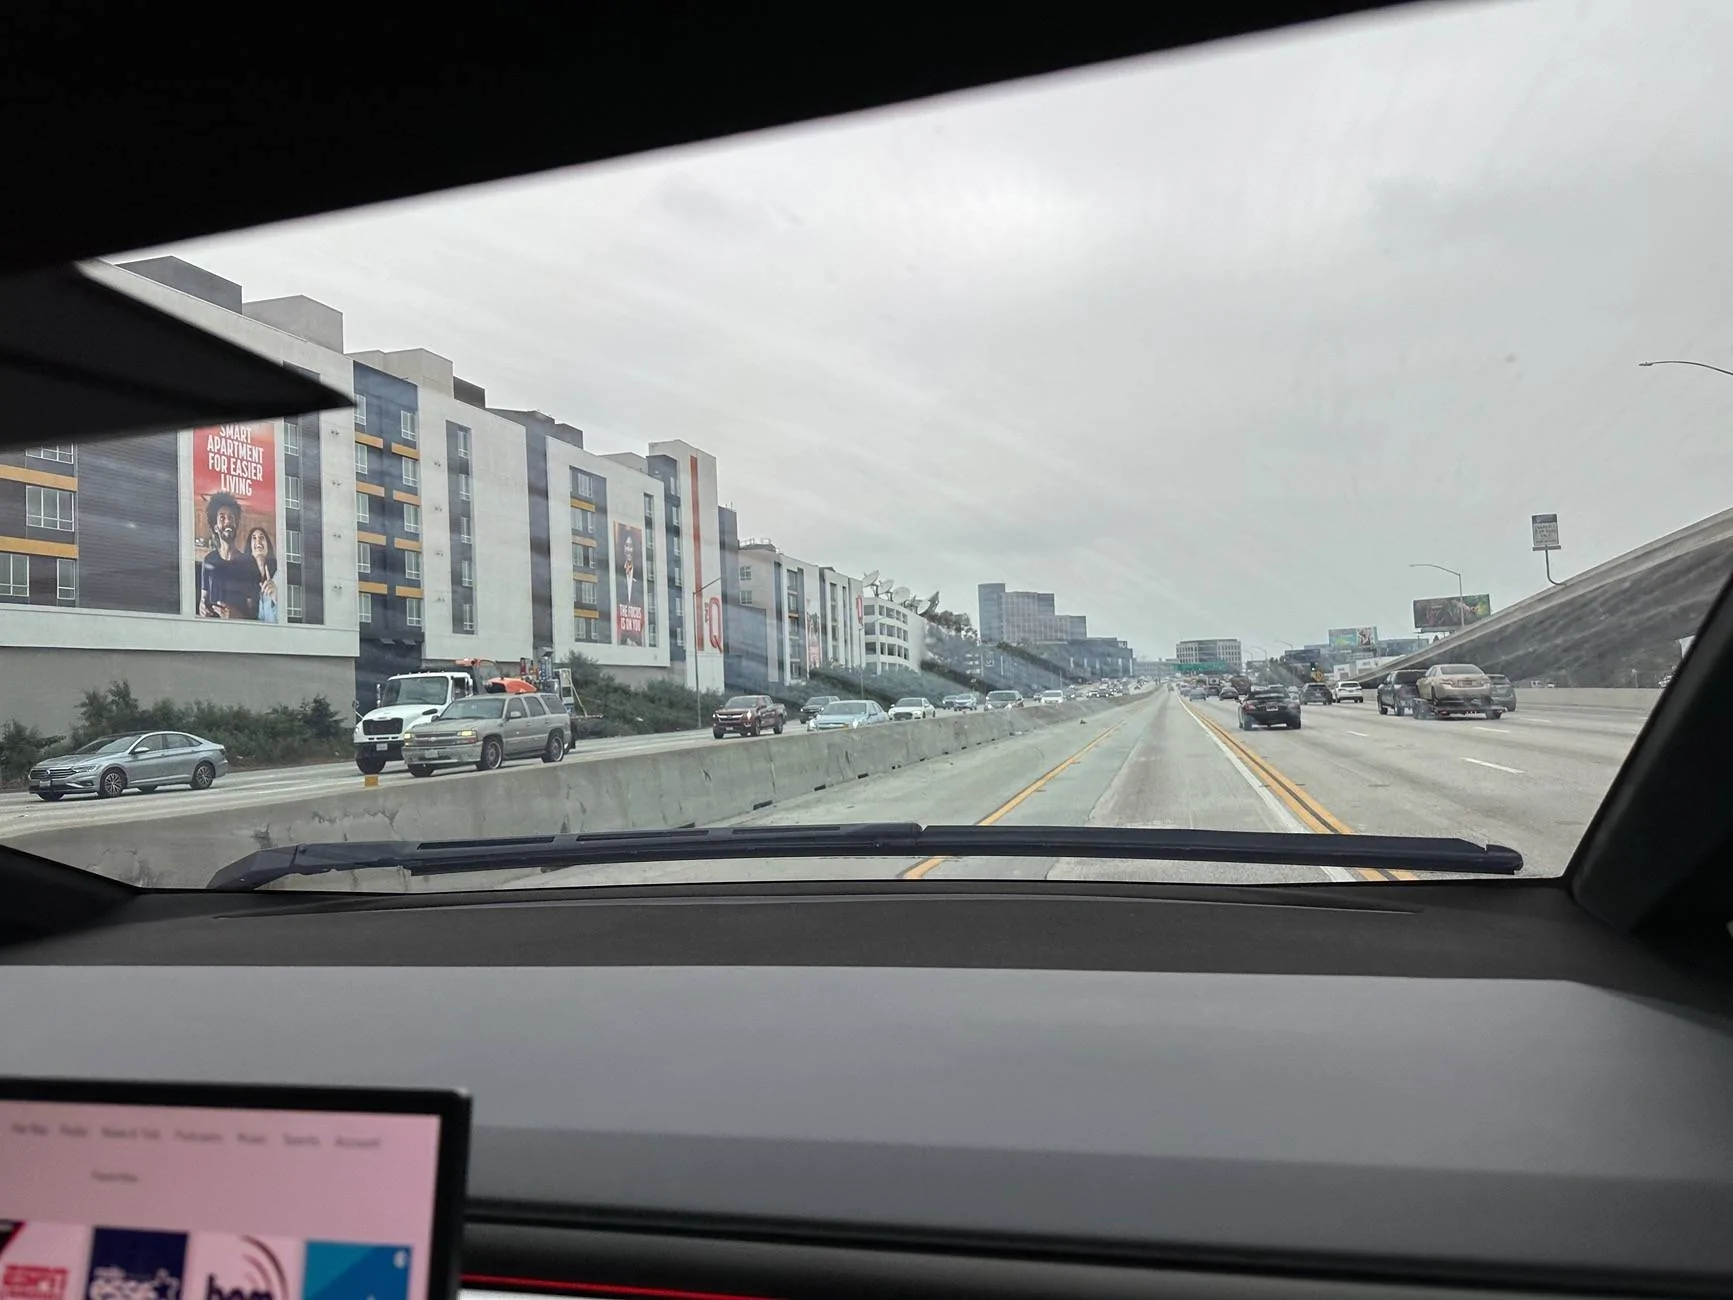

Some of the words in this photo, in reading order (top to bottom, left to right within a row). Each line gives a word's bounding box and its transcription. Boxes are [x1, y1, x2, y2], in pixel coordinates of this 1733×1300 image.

[219, 424, 252, 443] SMART
[207, 434, 264, 464] APARTMENT
[208, 452, 228, 474] FOR
[230, 457, 263, 482] EASIER
[220, 473, 253, 496] LIVING
